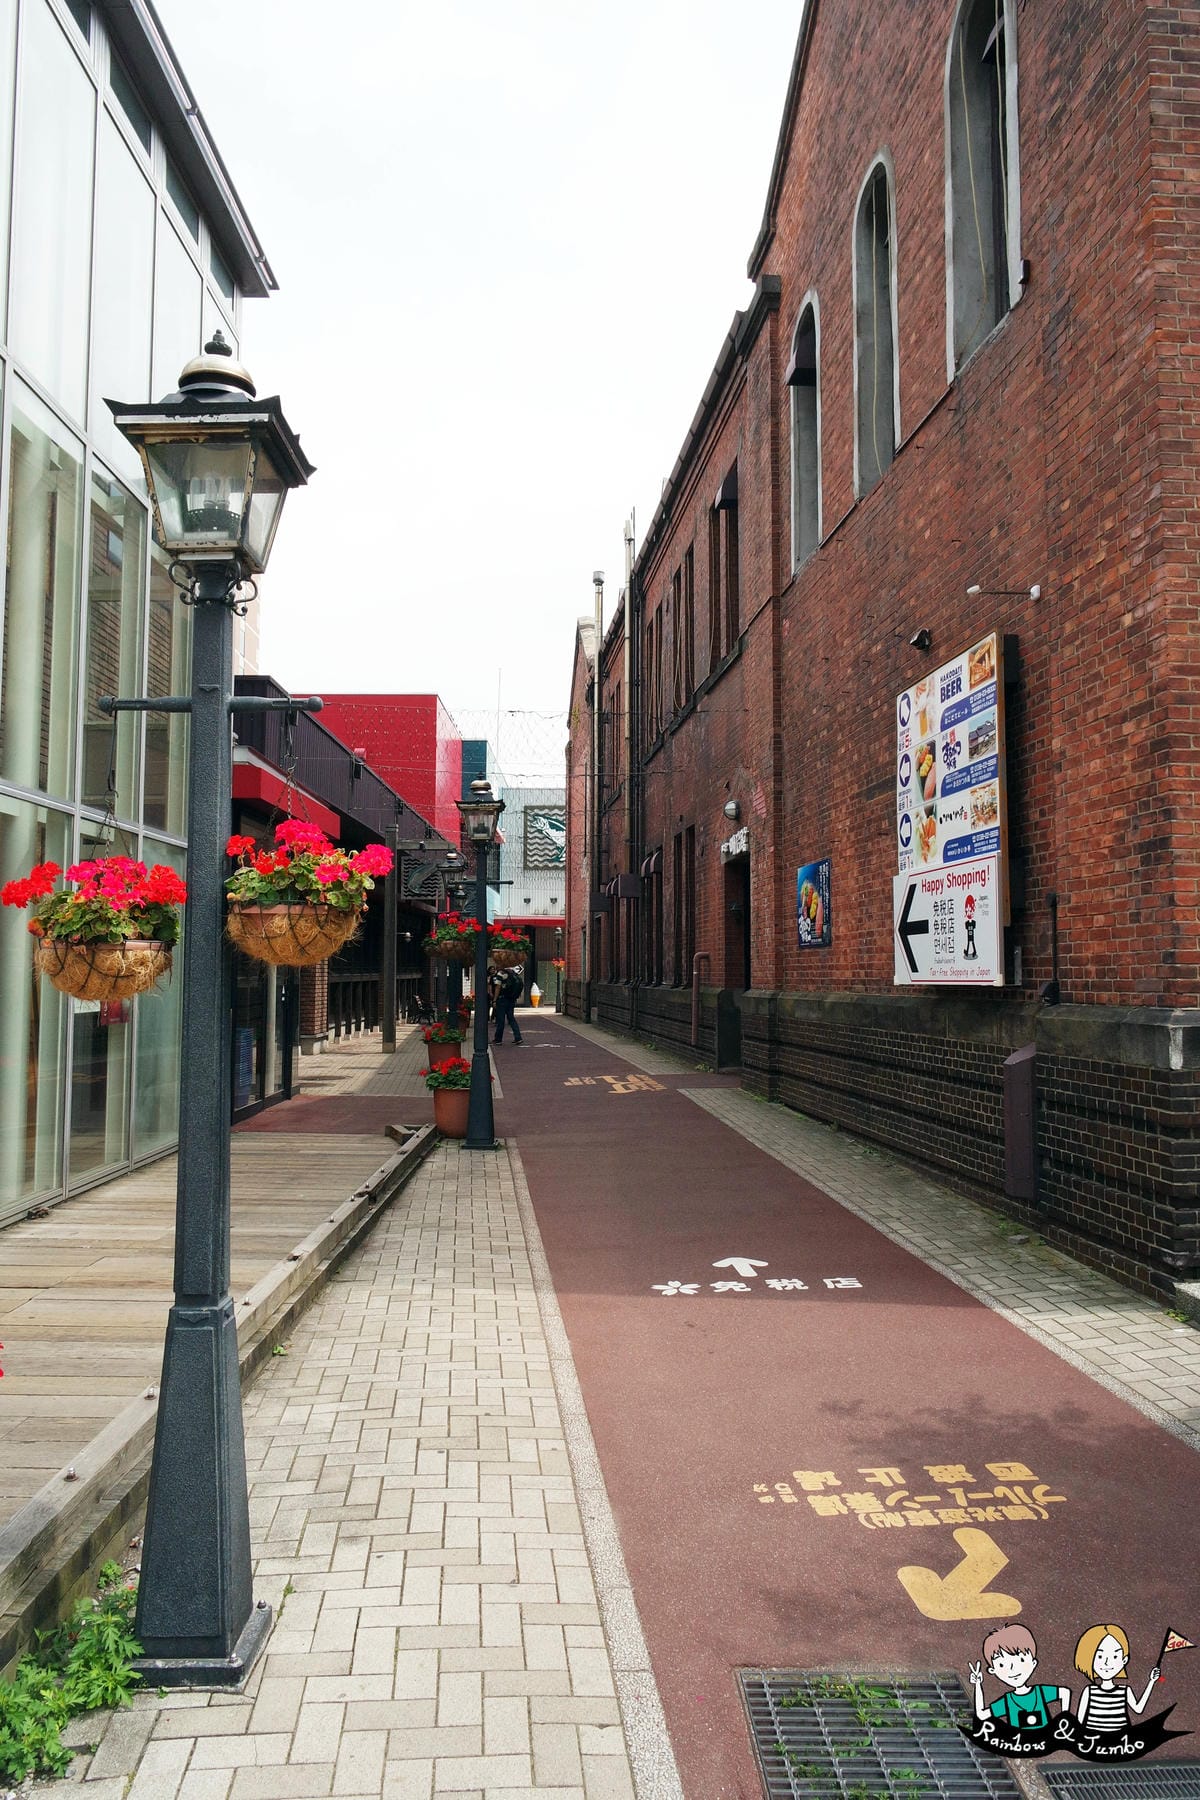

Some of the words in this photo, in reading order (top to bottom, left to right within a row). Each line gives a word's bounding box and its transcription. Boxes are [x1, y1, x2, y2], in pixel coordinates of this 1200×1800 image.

[940, 676, 962, 704] BEER
[921, 877, 944, 896] Happy
[946, 864, 990, 891] Shopping!
[933, 899, 954, 917] 免税店
[934, 937, 955, 955] 면세점
[949, 966, 969, 979] Shopping
[970, 968, 975, 976] in
[976, 966, 991, 979] Japan
[709, 1277, 863, 1293] 免税店
